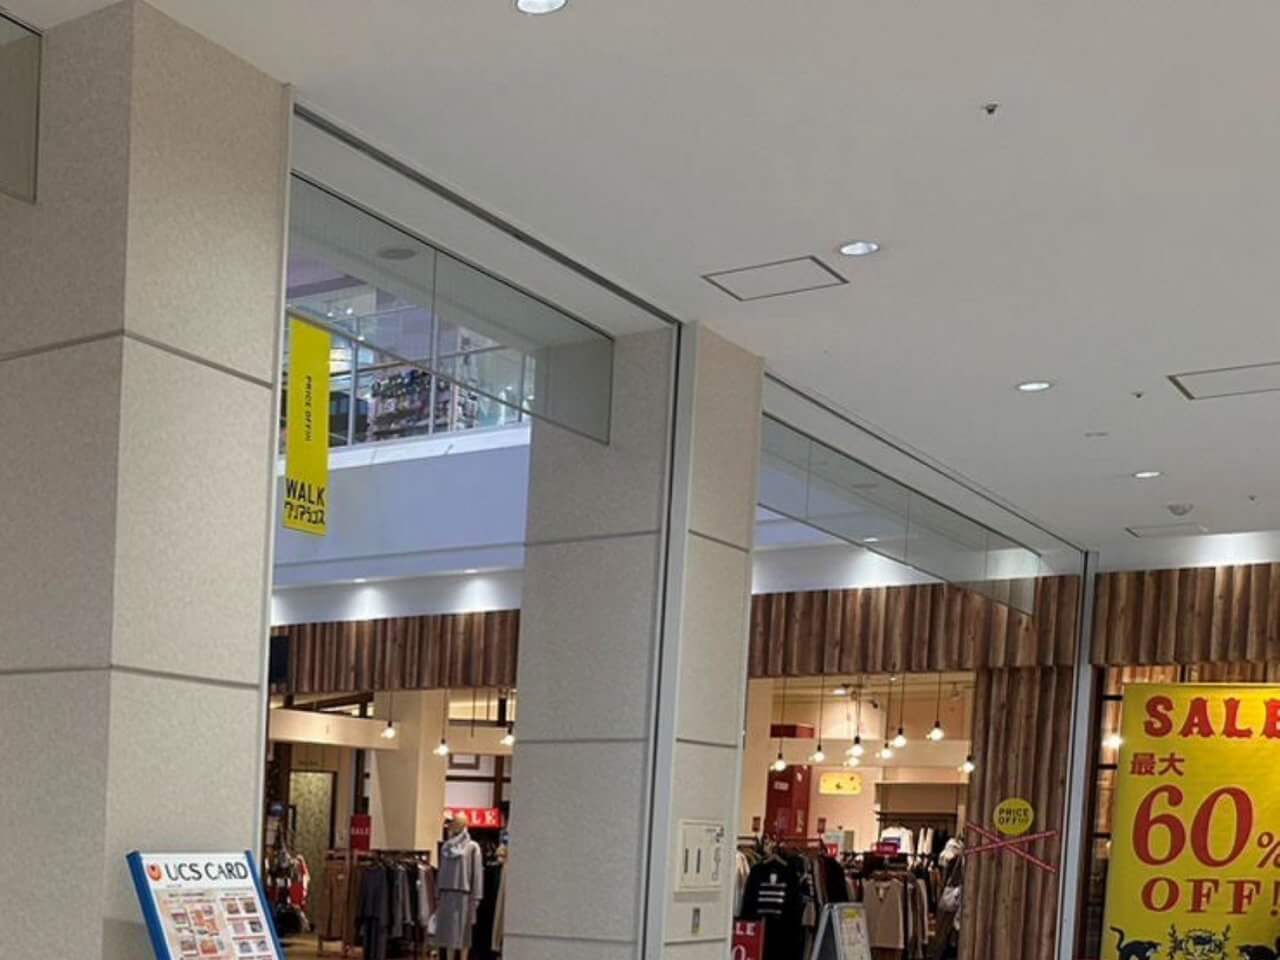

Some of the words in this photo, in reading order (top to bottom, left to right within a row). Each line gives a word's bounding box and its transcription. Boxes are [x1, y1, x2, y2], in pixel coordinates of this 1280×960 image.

[285, 478, 326, 507] WALK
[1143, 695, 1280, 738] SALE
[1130, 752, 1185, 776] 最大
[999, 807, 1029, 817] PRICE
[164, 863, 202, 881] UCS
[204, 861, 249, 880] CARD
[735, 922, 756, 936] LE
